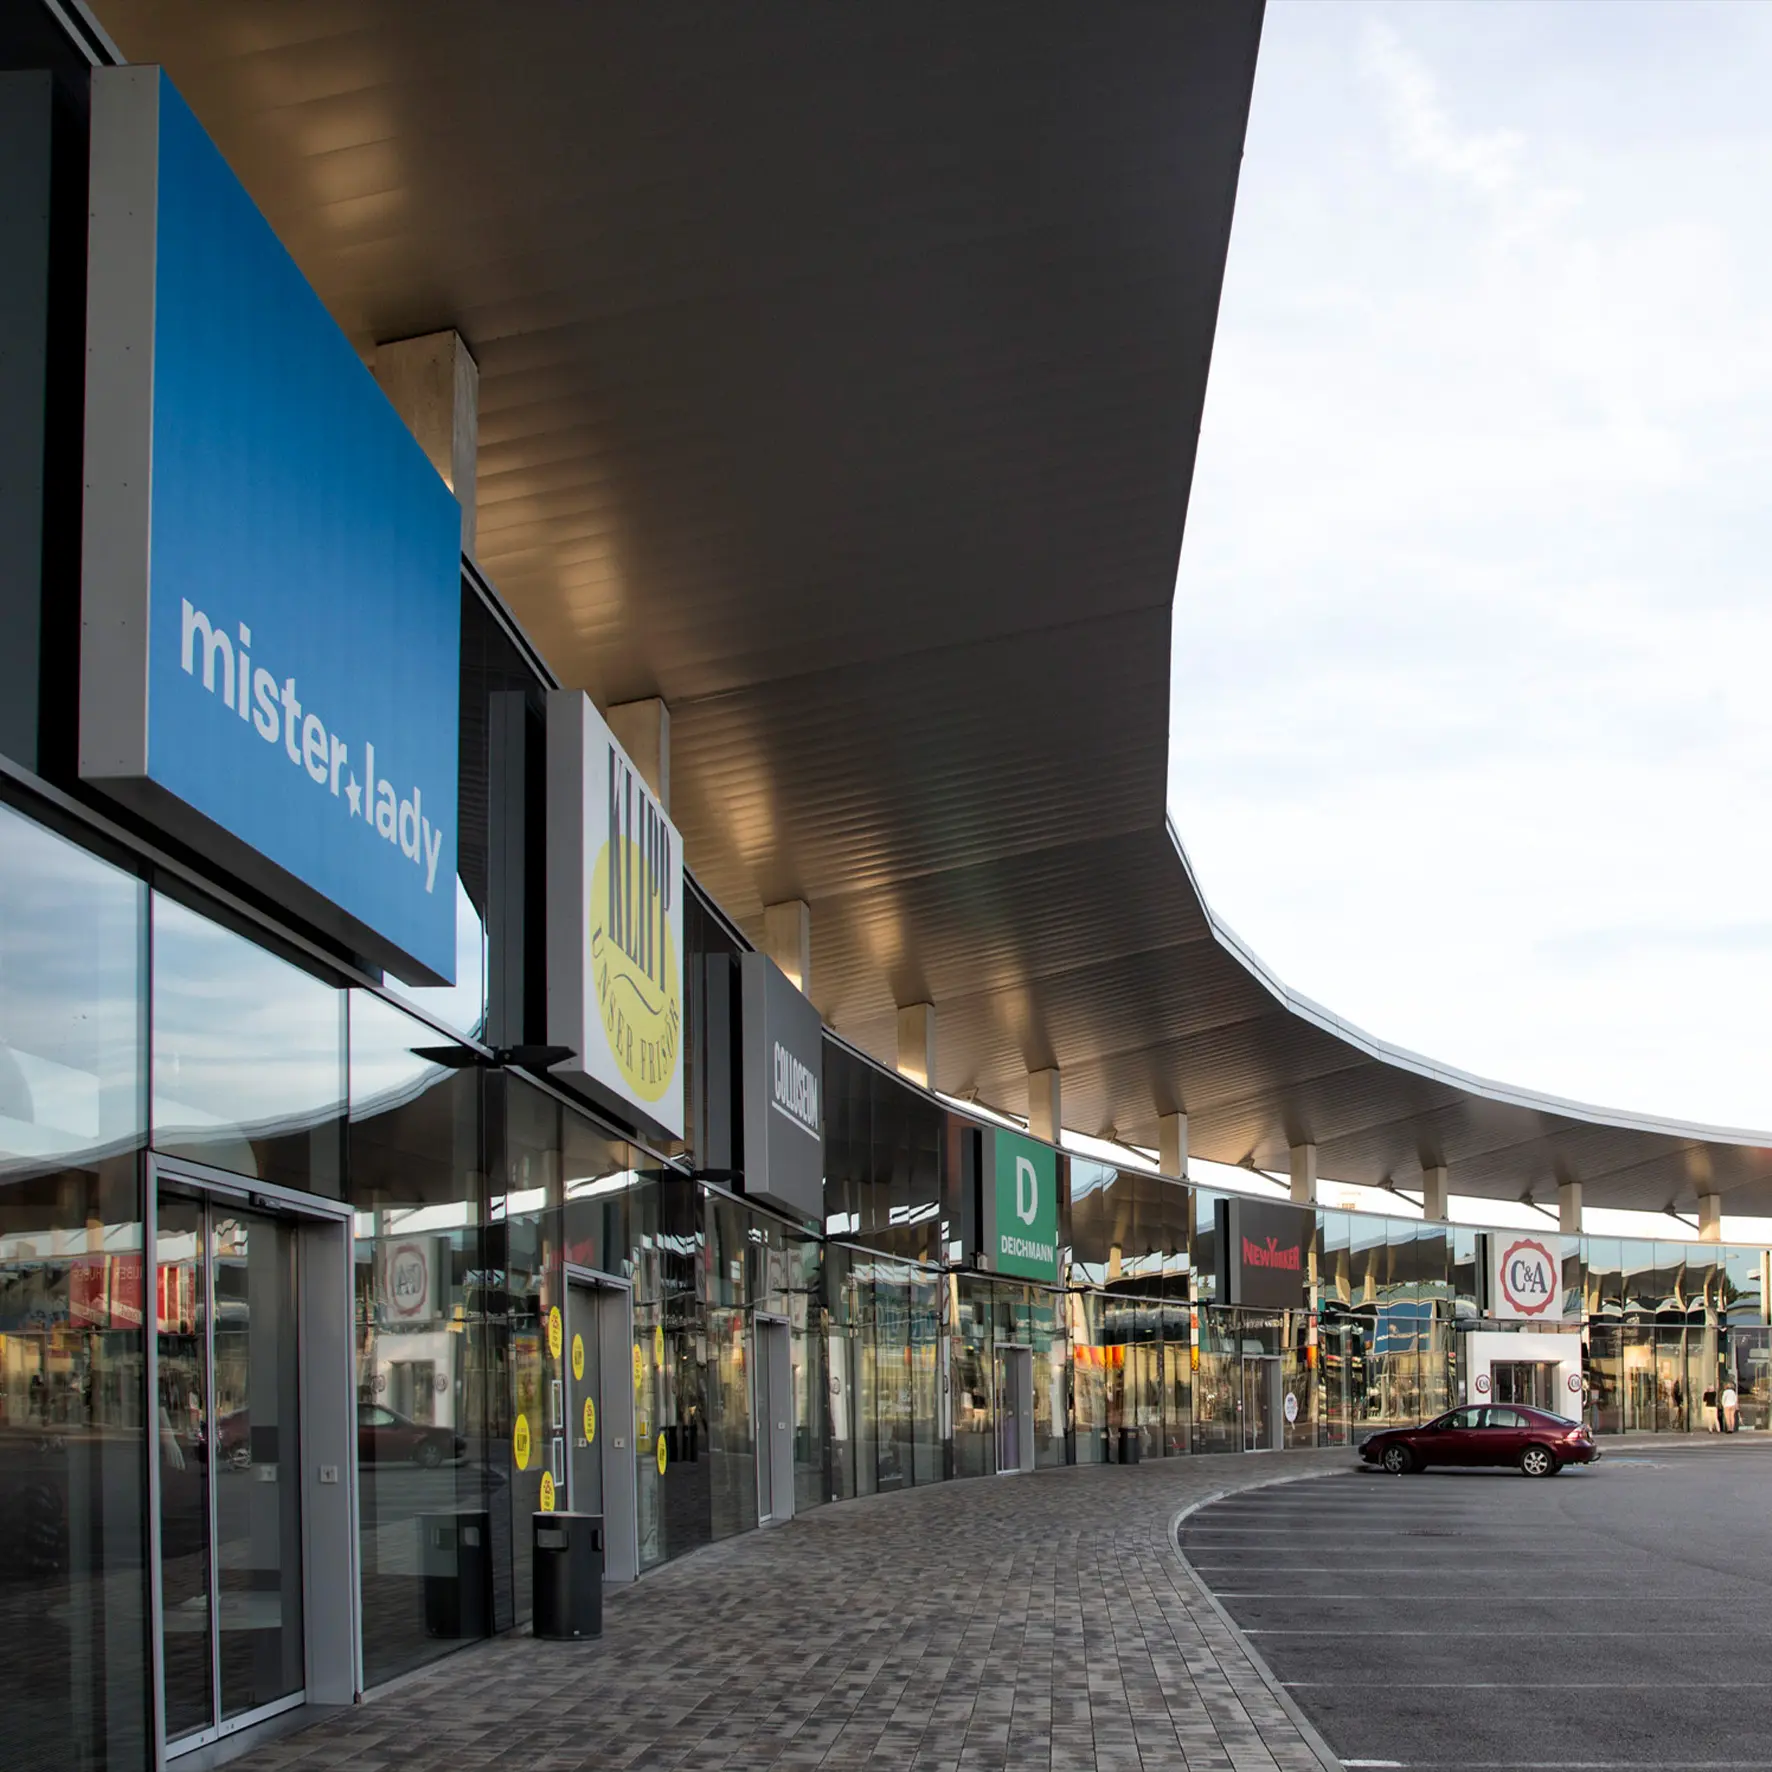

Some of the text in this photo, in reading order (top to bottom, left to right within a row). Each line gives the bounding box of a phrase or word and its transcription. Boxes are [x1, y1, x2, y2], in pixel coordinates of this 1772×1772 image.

[608, 742, 671, 994] KLIPP
[592, 926, 633, 1072] UNSER
[774, 1040, 818, 1130] COLLOSEUM
[1015, 1155, 1039, 1225] D
[1001, 1235, 1054, 1263] DEICHMANN
[1510, 1260, 1548, 1293] C&A
